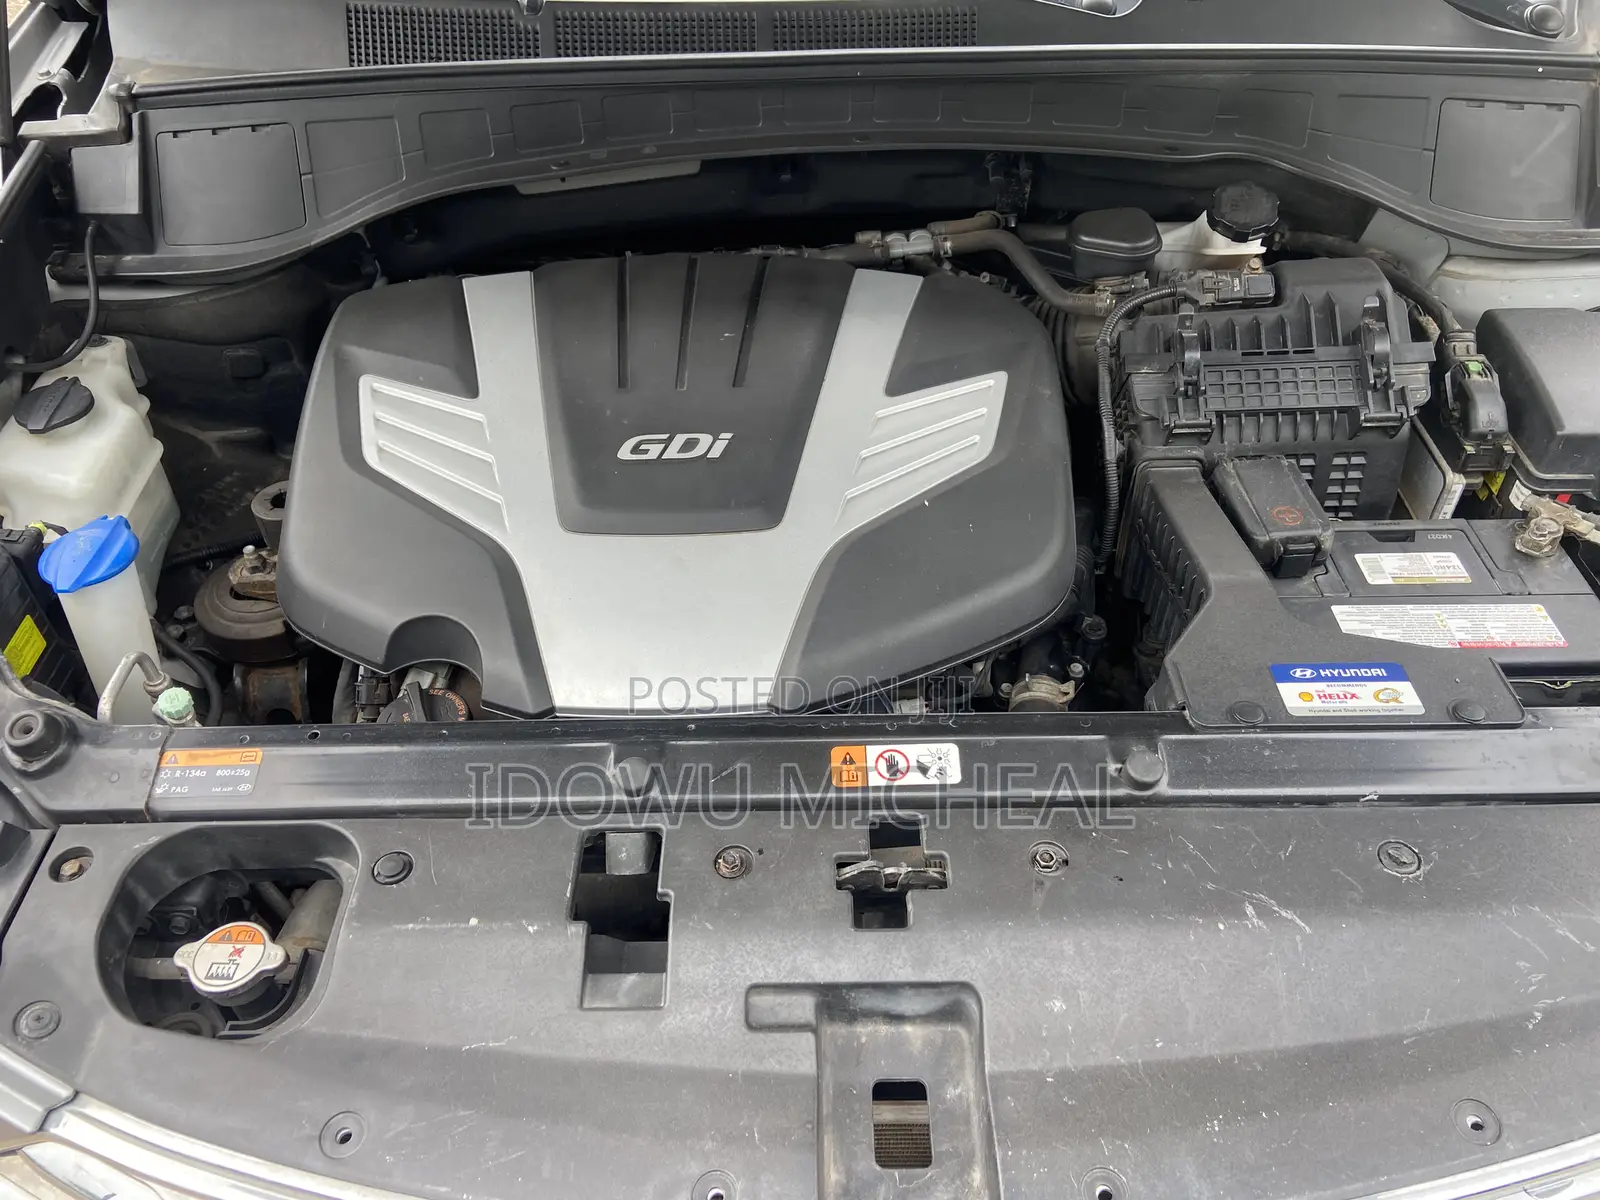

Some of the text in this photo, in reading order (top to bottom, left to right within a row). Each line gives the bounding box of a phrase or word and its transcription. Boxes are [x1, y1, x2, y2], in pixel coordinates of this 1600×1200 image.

[616, 432, 734, 460] GDi
[1320, 668, 1388, 677] HYUNDAI
[428, 688, 445, 696] SEE
[1317, 692, 1361, 700] HELIX
[174, 769, 207, 778] R-134a
